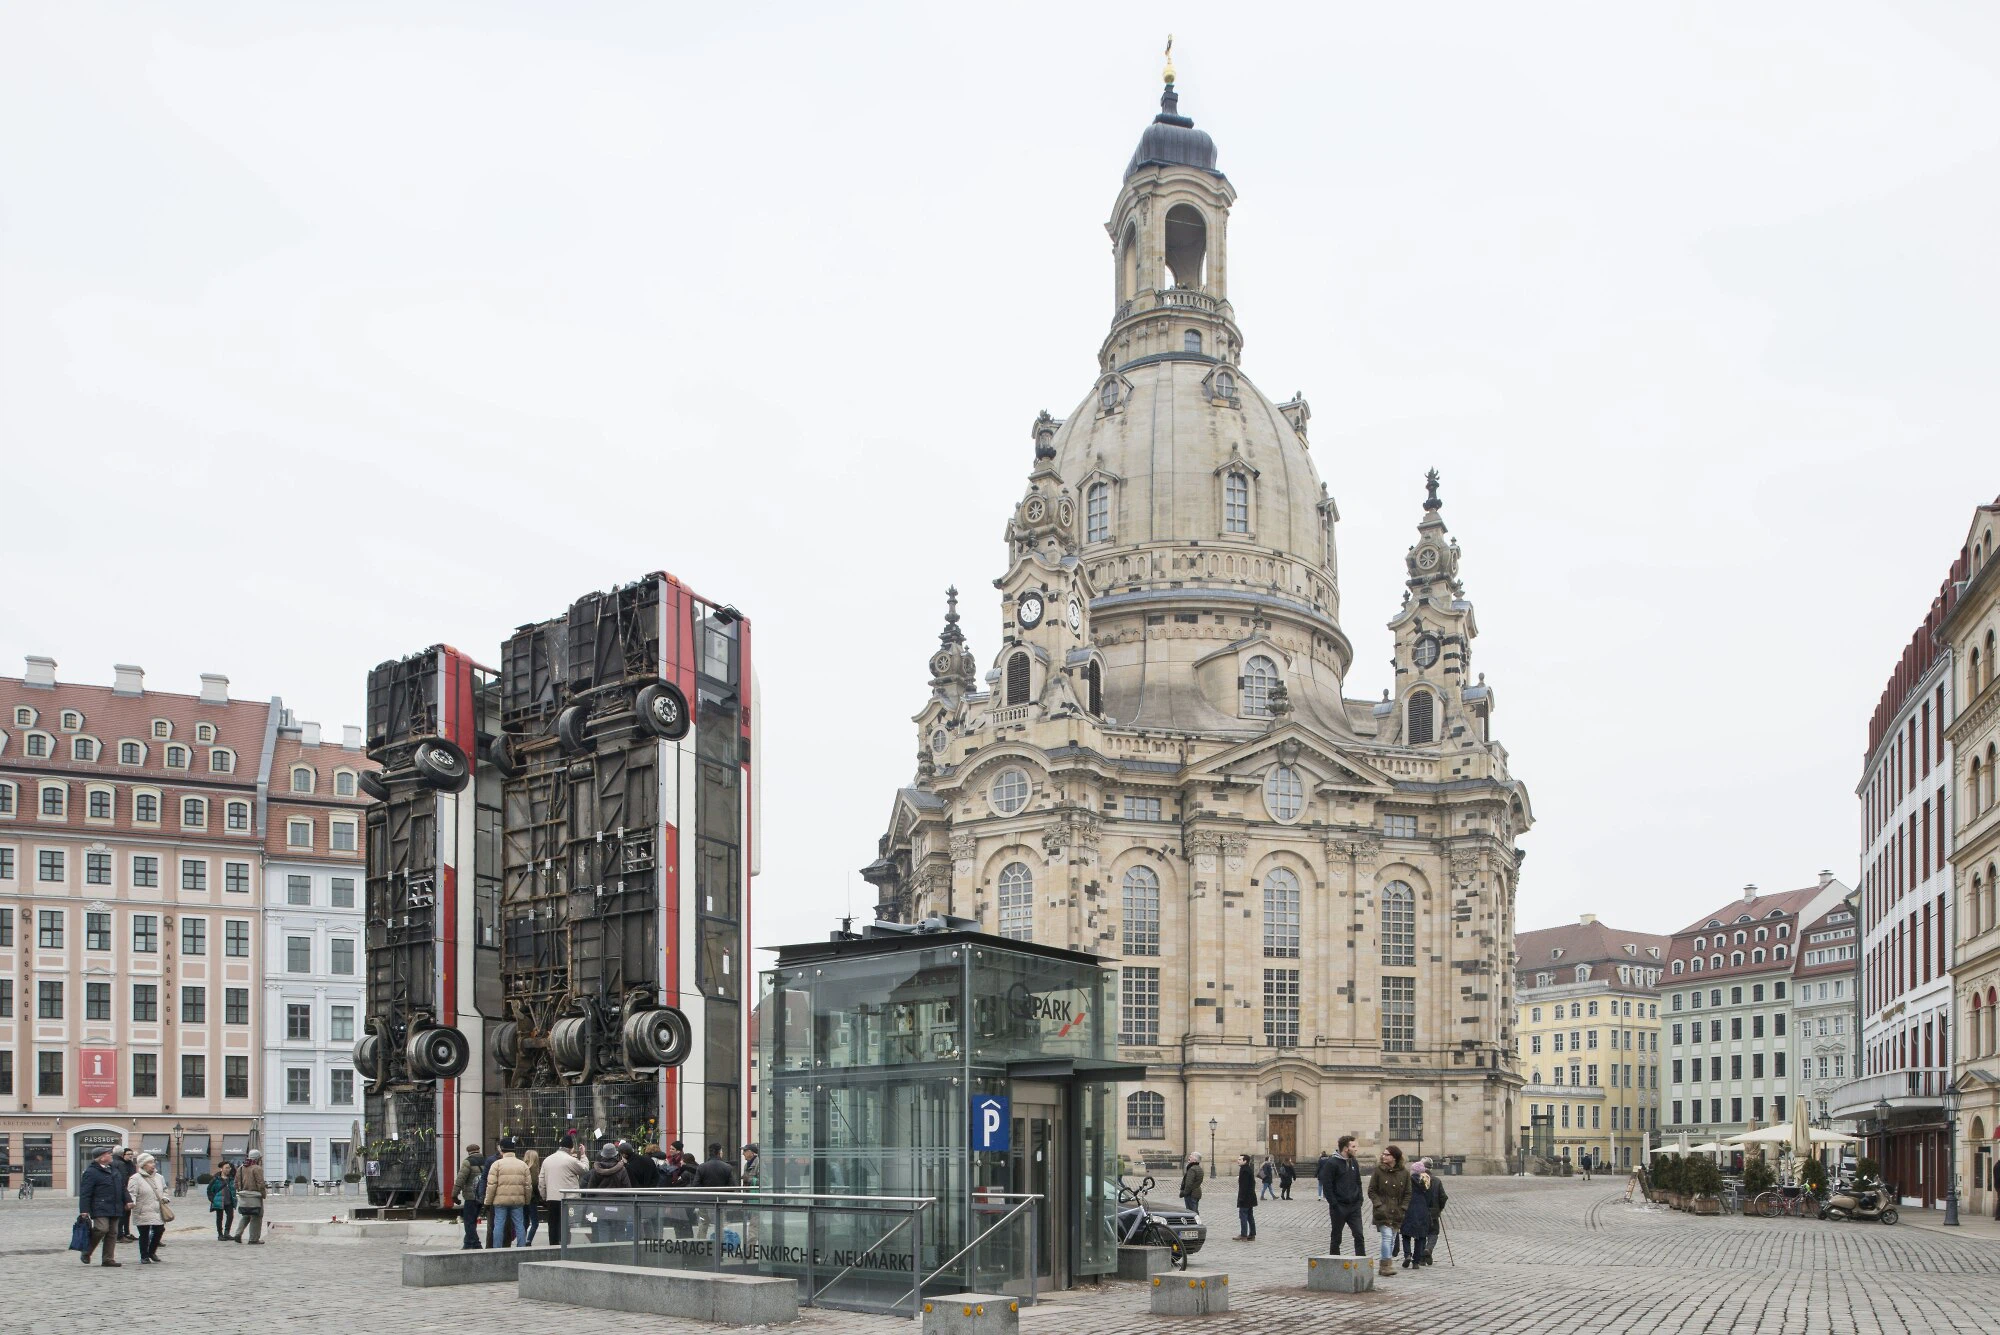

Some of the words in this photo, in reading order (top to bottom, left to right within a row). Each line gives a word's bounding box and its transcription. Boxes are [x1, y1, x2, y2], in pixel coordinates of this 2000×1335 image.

[983, 1108, 1000, 1147] P
[643, 1238, 713, 1257] TIEFGARAGE
[721, 1242, 820, 1265] FRAUENKIRCHE
[834, 1249, 914, 1272] NEUMARKT
